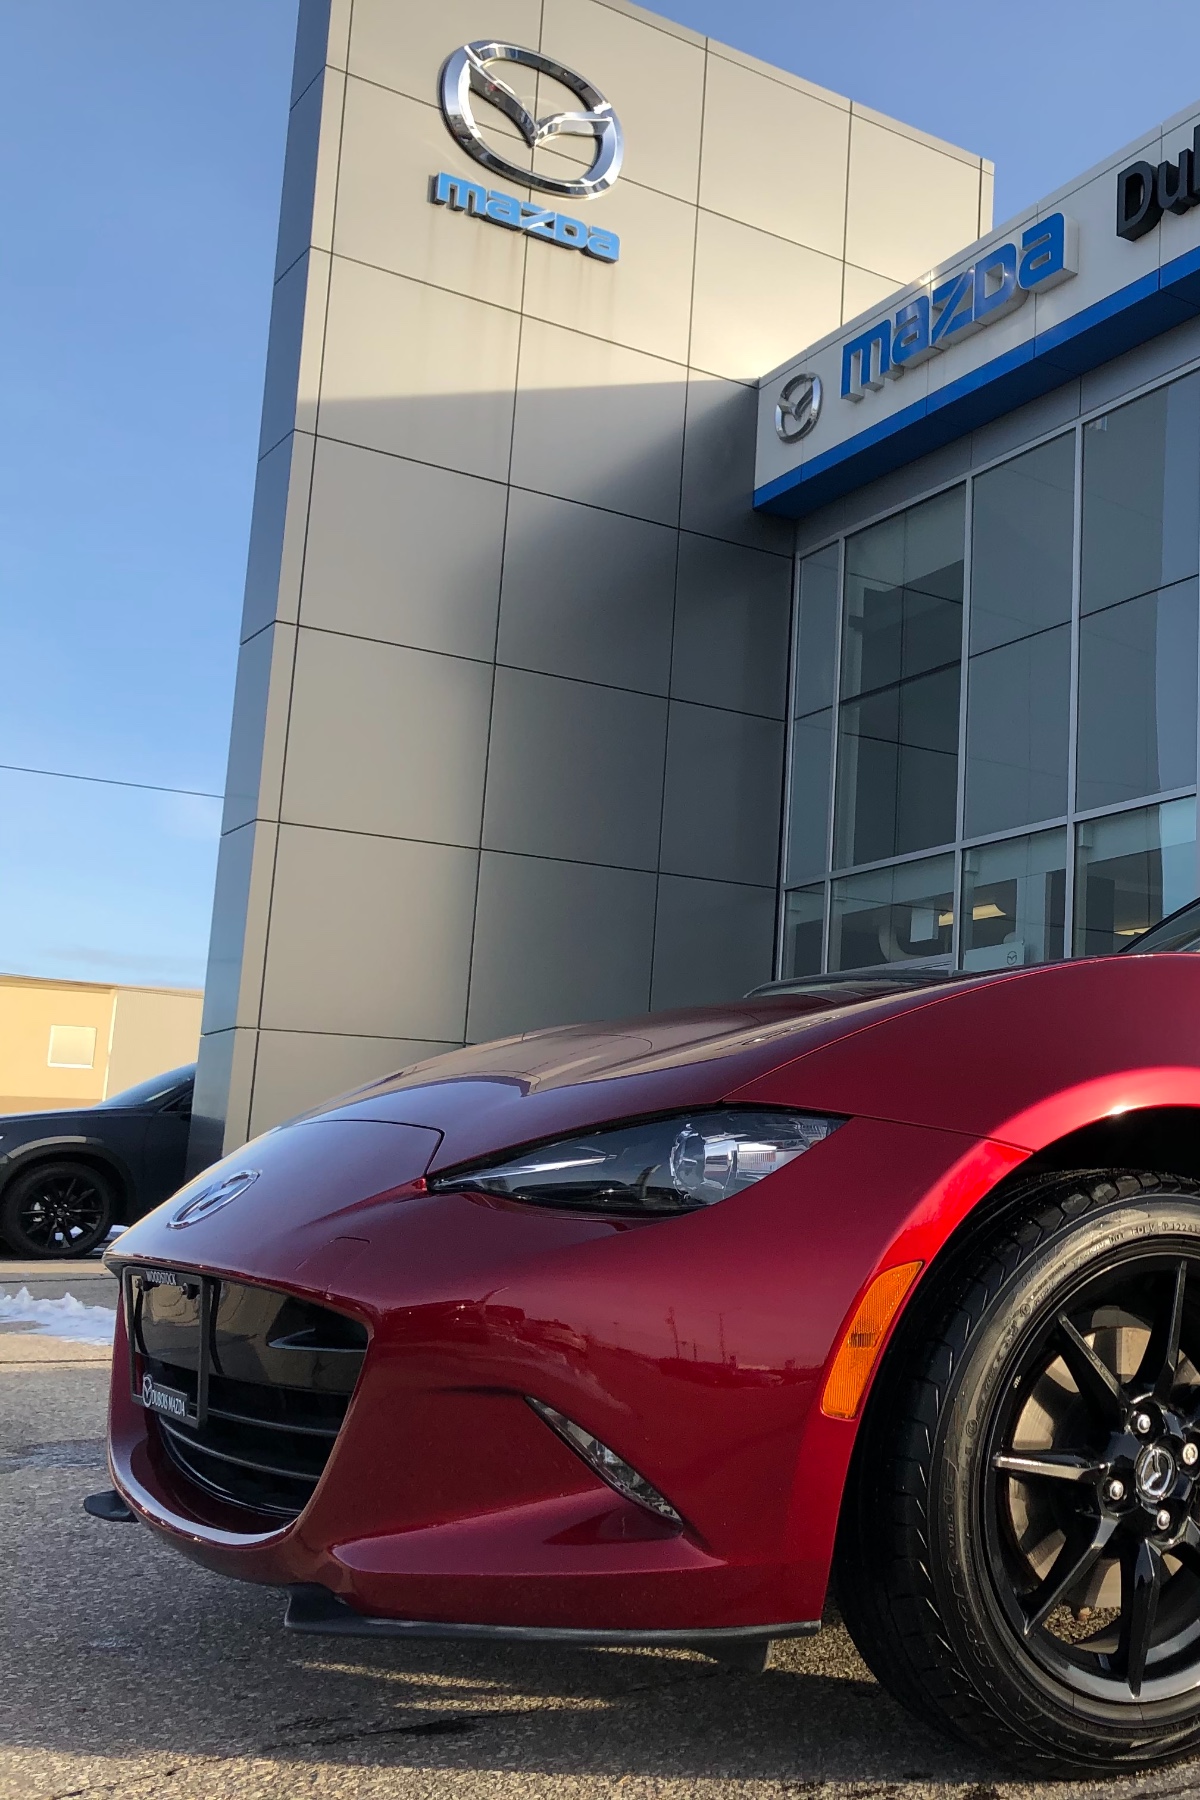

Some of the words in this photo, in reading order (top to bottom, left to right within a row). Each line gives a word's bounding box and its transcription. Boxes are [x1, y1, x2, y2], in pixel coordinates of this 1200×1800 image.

[432, 171, 620, 263] mazda
[840, 212, 1079, 402] mazda
[145, 1270, 177, 1286] WOODSTOCK
[168, 1395, 186, 1417] MAZDA
